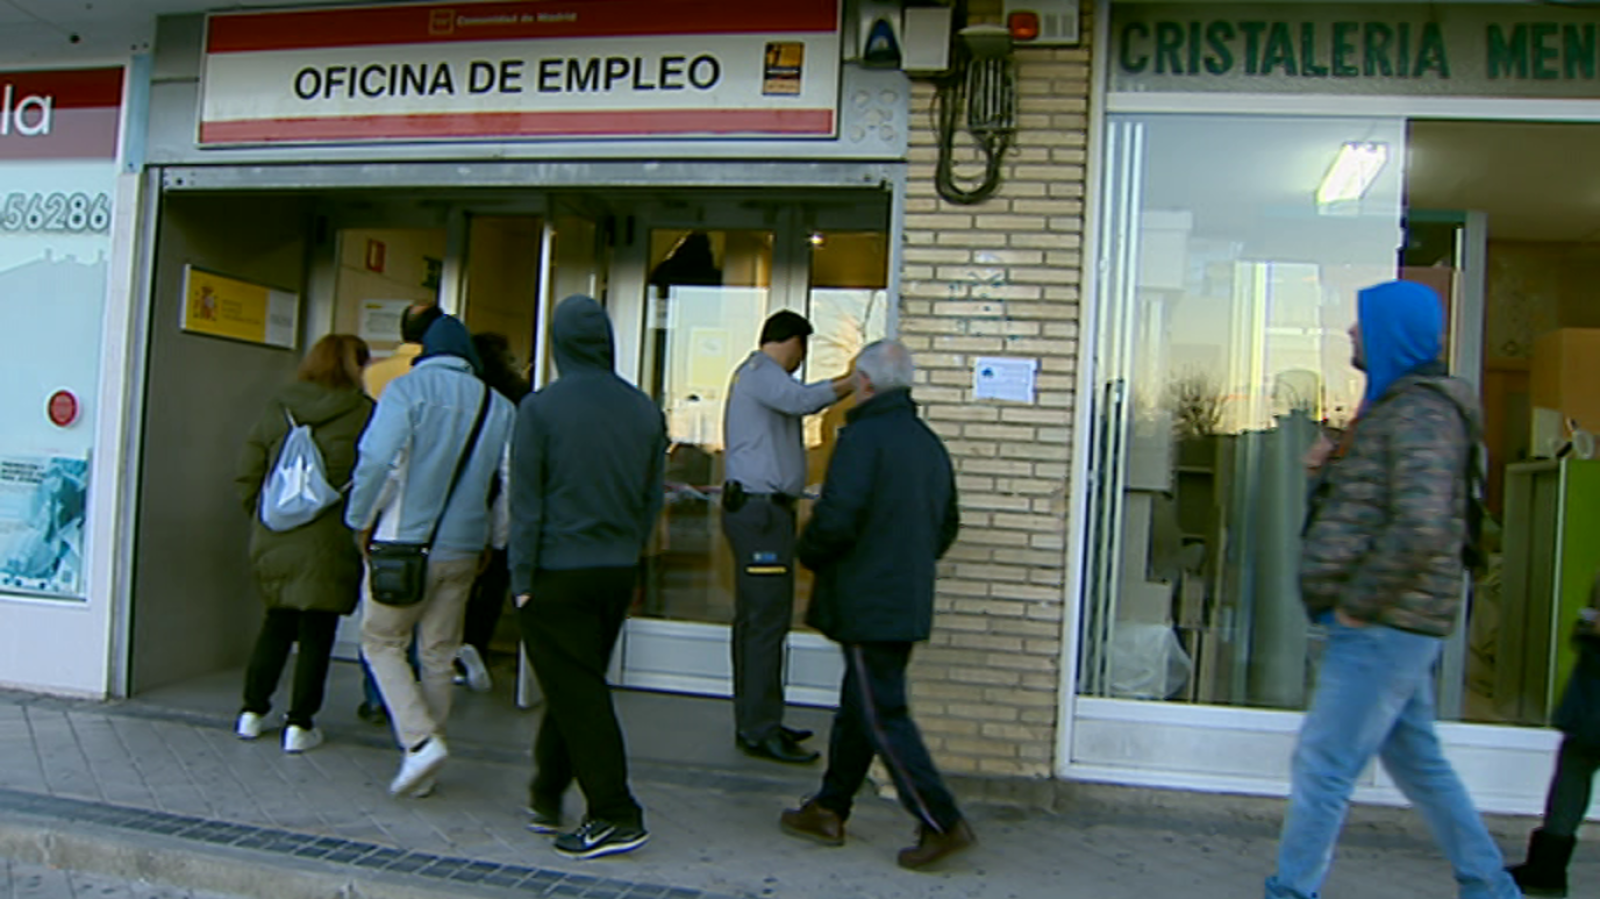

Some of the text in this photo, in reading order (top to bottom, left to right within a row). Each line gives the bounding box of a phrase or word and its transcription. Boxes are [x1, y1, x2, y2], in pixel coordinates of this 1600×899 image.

[1119, 21, 1600, 80] CRISTALERIA MEN
[294, 54, 720, 100] OFICINA DE EMPLEO
[0, 84, 52, 136] la
